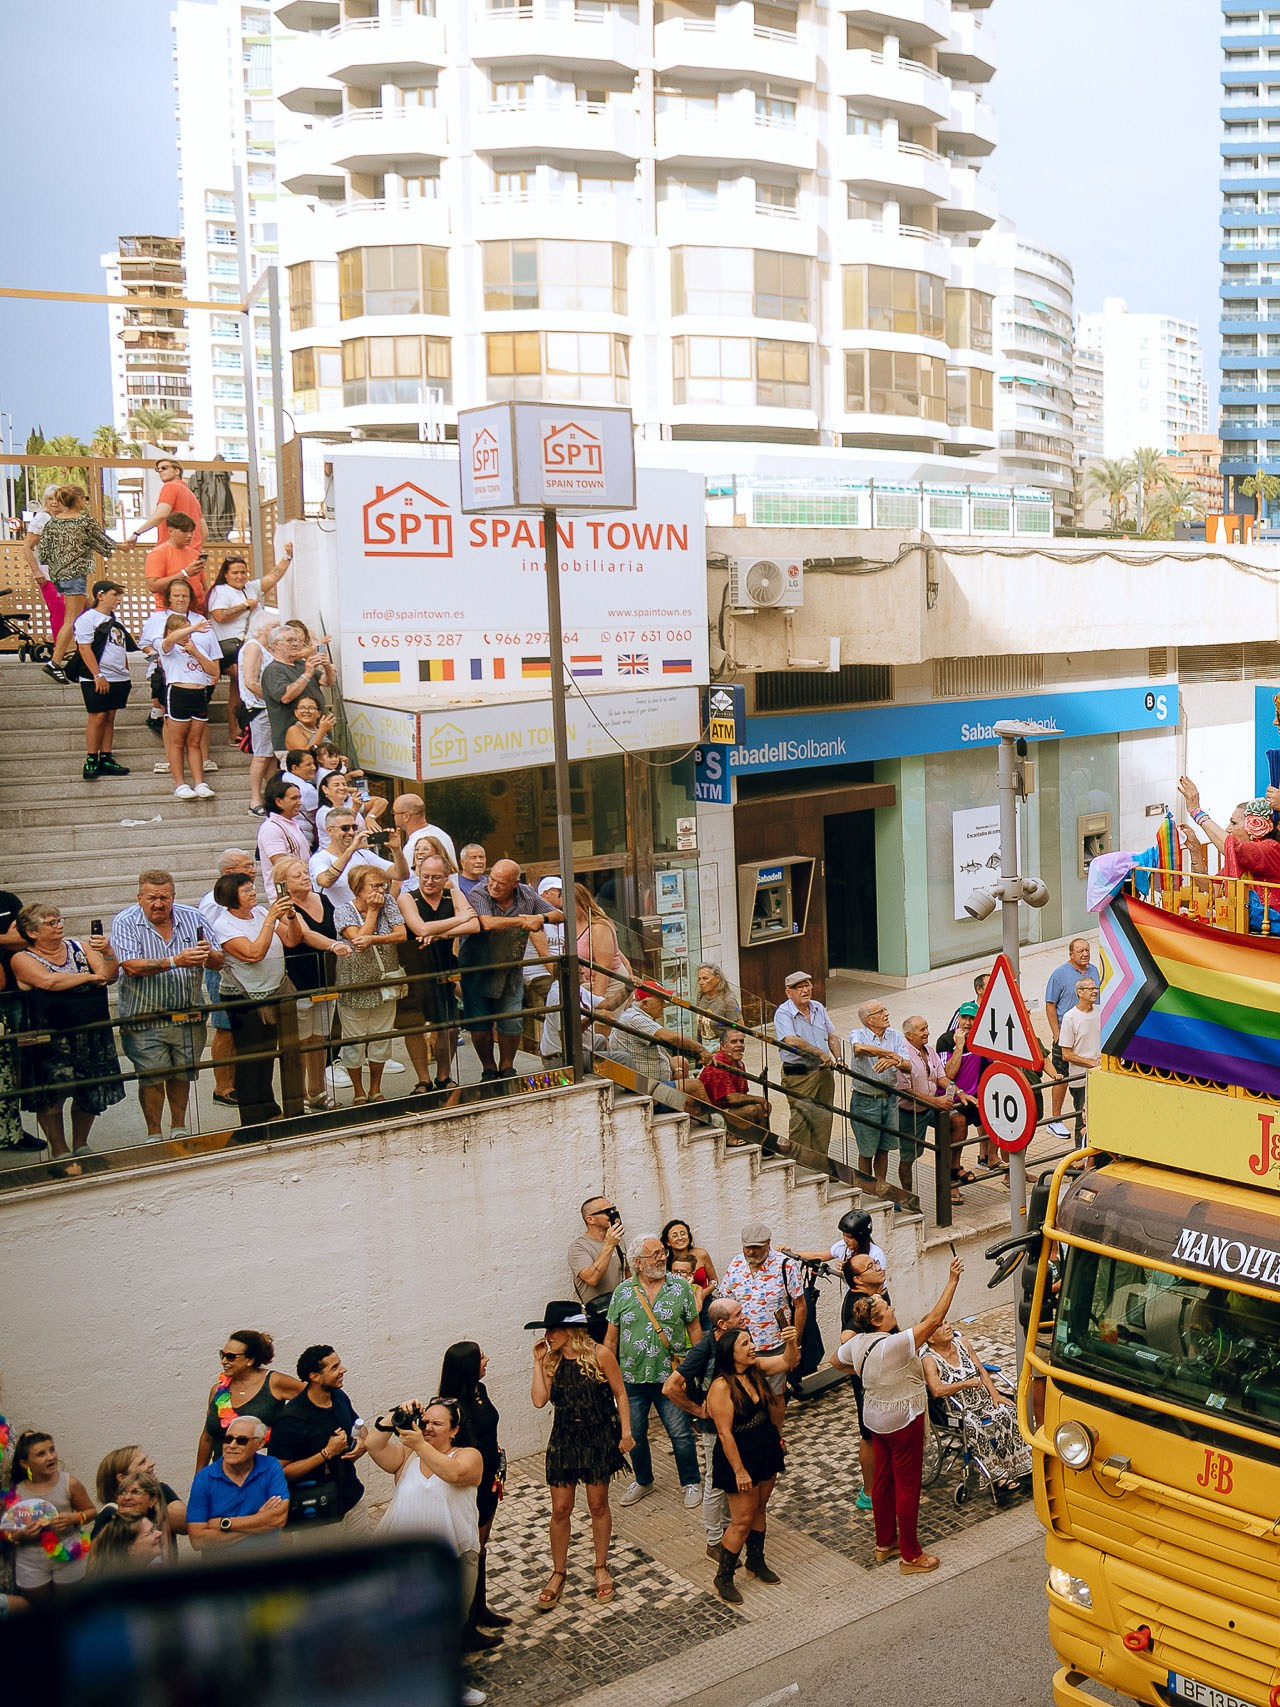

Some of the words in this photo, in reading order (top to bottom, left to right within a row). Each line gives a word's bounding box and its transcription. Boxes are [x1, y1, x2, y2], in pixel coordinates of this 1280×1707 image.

[547, 444, 602, 466] SPT
[546, 479, 574, 488] SPAIN
[576, 480, 604, 488] TOWN
[374, 513, 453, 545] SPT
[470, 518, 574, 549] SPAIN
[586, 521, 688, 551] TOWN
[522, 558, 644, 572] inobiliaria
[362, 608, 465, 621] info@spaintown.es
[608, 607, 693, 619] www.spaintown.es
[372, 635, 400, 647] 965
[404, 634, 433, 646] 993
[437, 633, 463, 646] 287
[495, 633, 521, 645] 966
[615, 632, 636, 643] 617
[641, 631, 662, 642] 631
[667, 630, 693, 642] 060
[474, 731, 523, 753] SPAIN
[528, 724, 576, 747] TON
[711, 723, 734, 739] ATM
[432, 737, 467, 759] SPT
[729, 737, 847, 766] abadellSolbank
[991, 1091, 1018, 1124] 10
[1197, 1449, 1233, 1494] J&B
[1184, 1679, 1206, 1701] BF
